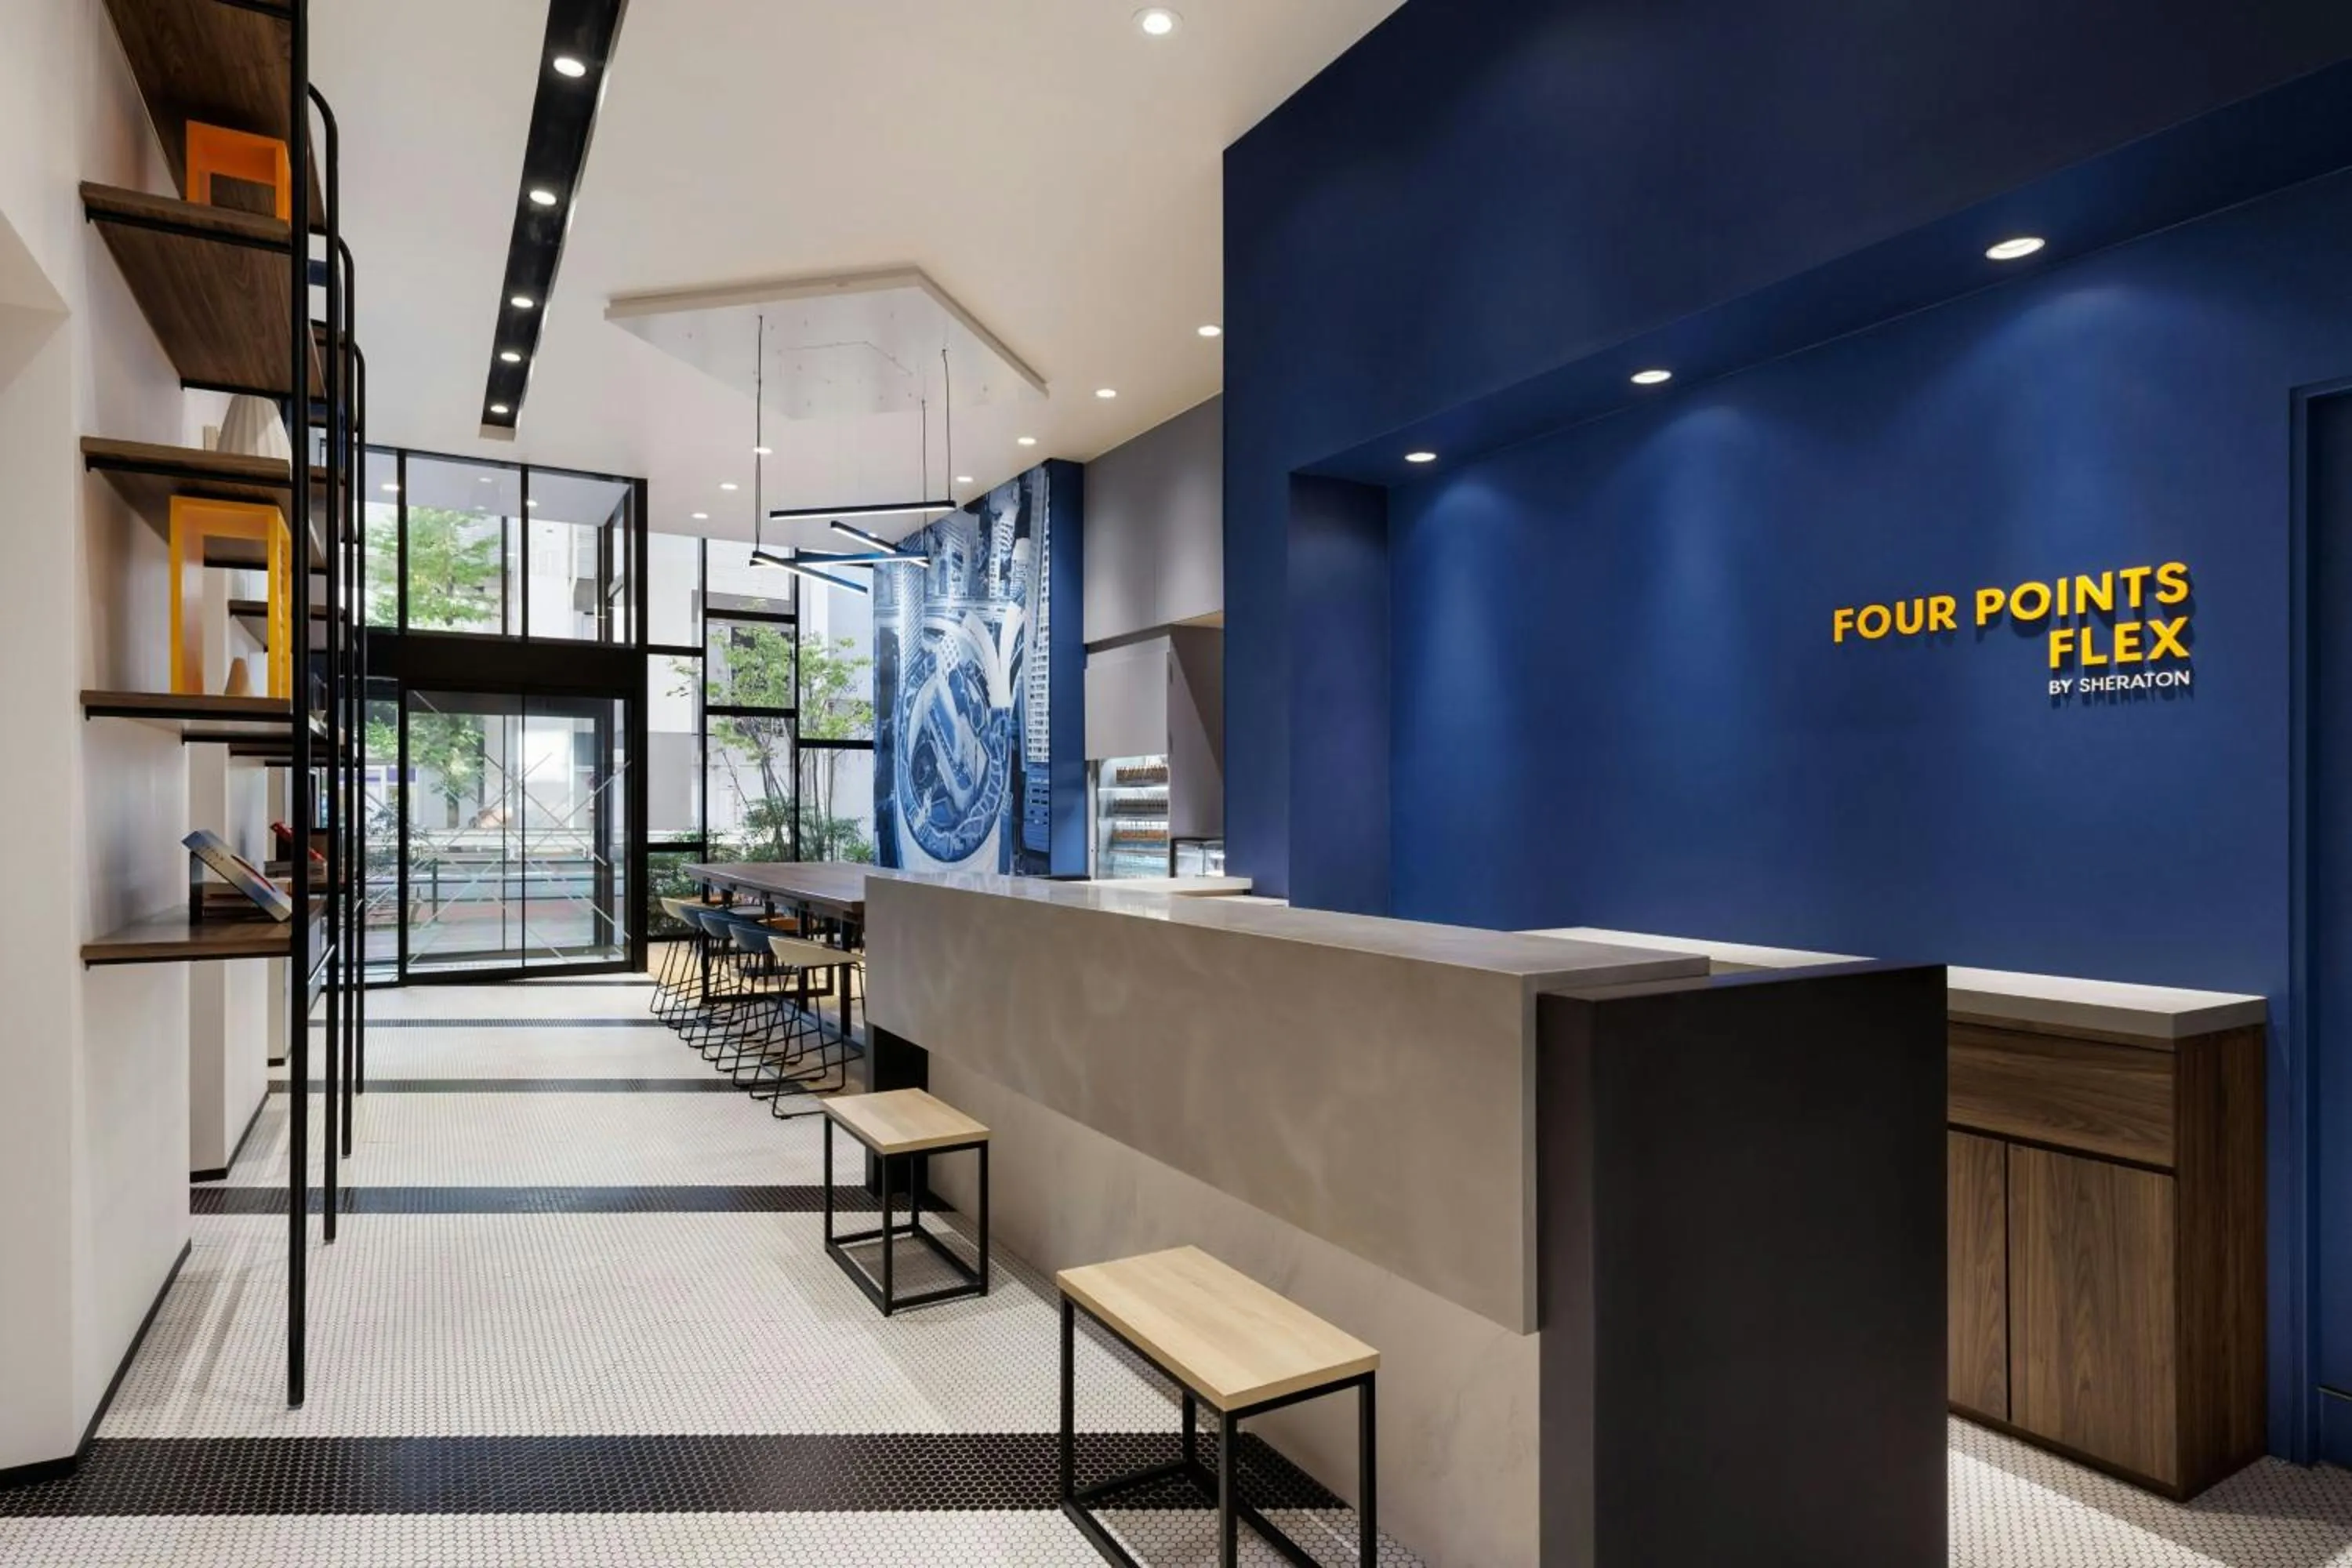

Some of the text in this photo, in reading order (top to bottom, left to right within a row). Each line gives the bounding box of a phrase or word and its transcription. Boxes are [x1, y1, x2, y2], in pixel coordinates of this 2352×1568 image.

[1833, 561, 2190, 643] FOUR POINTS
[2048, 616, 2190, 669] FLEX
[2048, 670, 2190, 695] BY SHERATON
